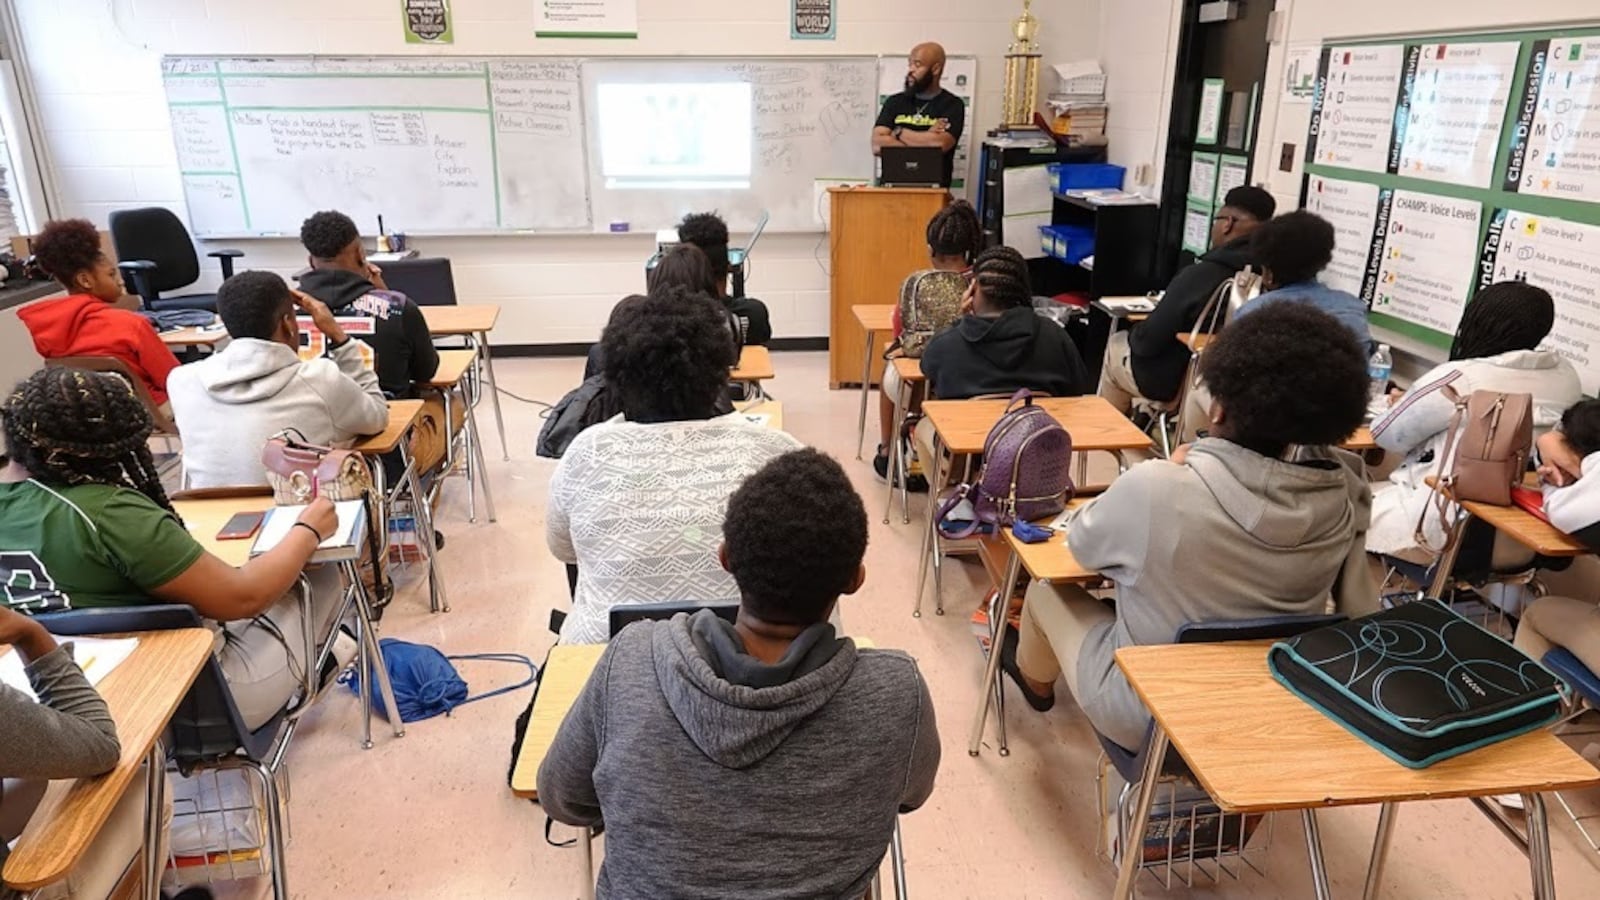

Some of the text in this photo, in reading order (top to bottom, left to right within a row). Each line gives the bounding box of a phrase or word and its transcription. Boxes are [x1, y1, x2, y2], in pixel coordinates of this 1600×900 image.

[797, 15, 829, 28] WORLD
[1425, 48, 1430, 59] C
[1554, 47, 1562, 59] C
[1547, 72, 1556, 85] H
[1309, 76, 1327, 136] Do Now
[1389, 46, 1419, 168] Indepnt Activity
[1542, 98, 1549, 111] A
[266, 113, 290, 127] Grab
[301, 115, 336, 128] handout
[1507, 52, 1545, 182] Class Discussion
[286, 127, 318, 137] handout
[1535, 124, 1547, 136] M
[1532, 149, 1539, 161] P
[1526, 175, 1584, 192] S Success!
[1396, 198, 1477, 221] CHAMPS: Voice Levels
[1368, 237, 1384, 276] Levels
[1376, 190, 1393, 236] Defined
[1392, 221, 1398, 234] 0
[1510, 218, 1516, 230] C
[1541, 226, 1560, 238] Voice
[1561, 229, 1578, 241] level
[1386, 246, 1392, 259] 1
[1479, 211, 1504, 291] nd-Talk
[1503, 241, 1512, 254] H
[1535, 251, 1548, 262] Ask
[1559, 256, 1582, 269] student
[1381, 270, 1388, 283] 2
[1498, 266, 1507, 278] A
[1377, 293, 1384, 306] 3
